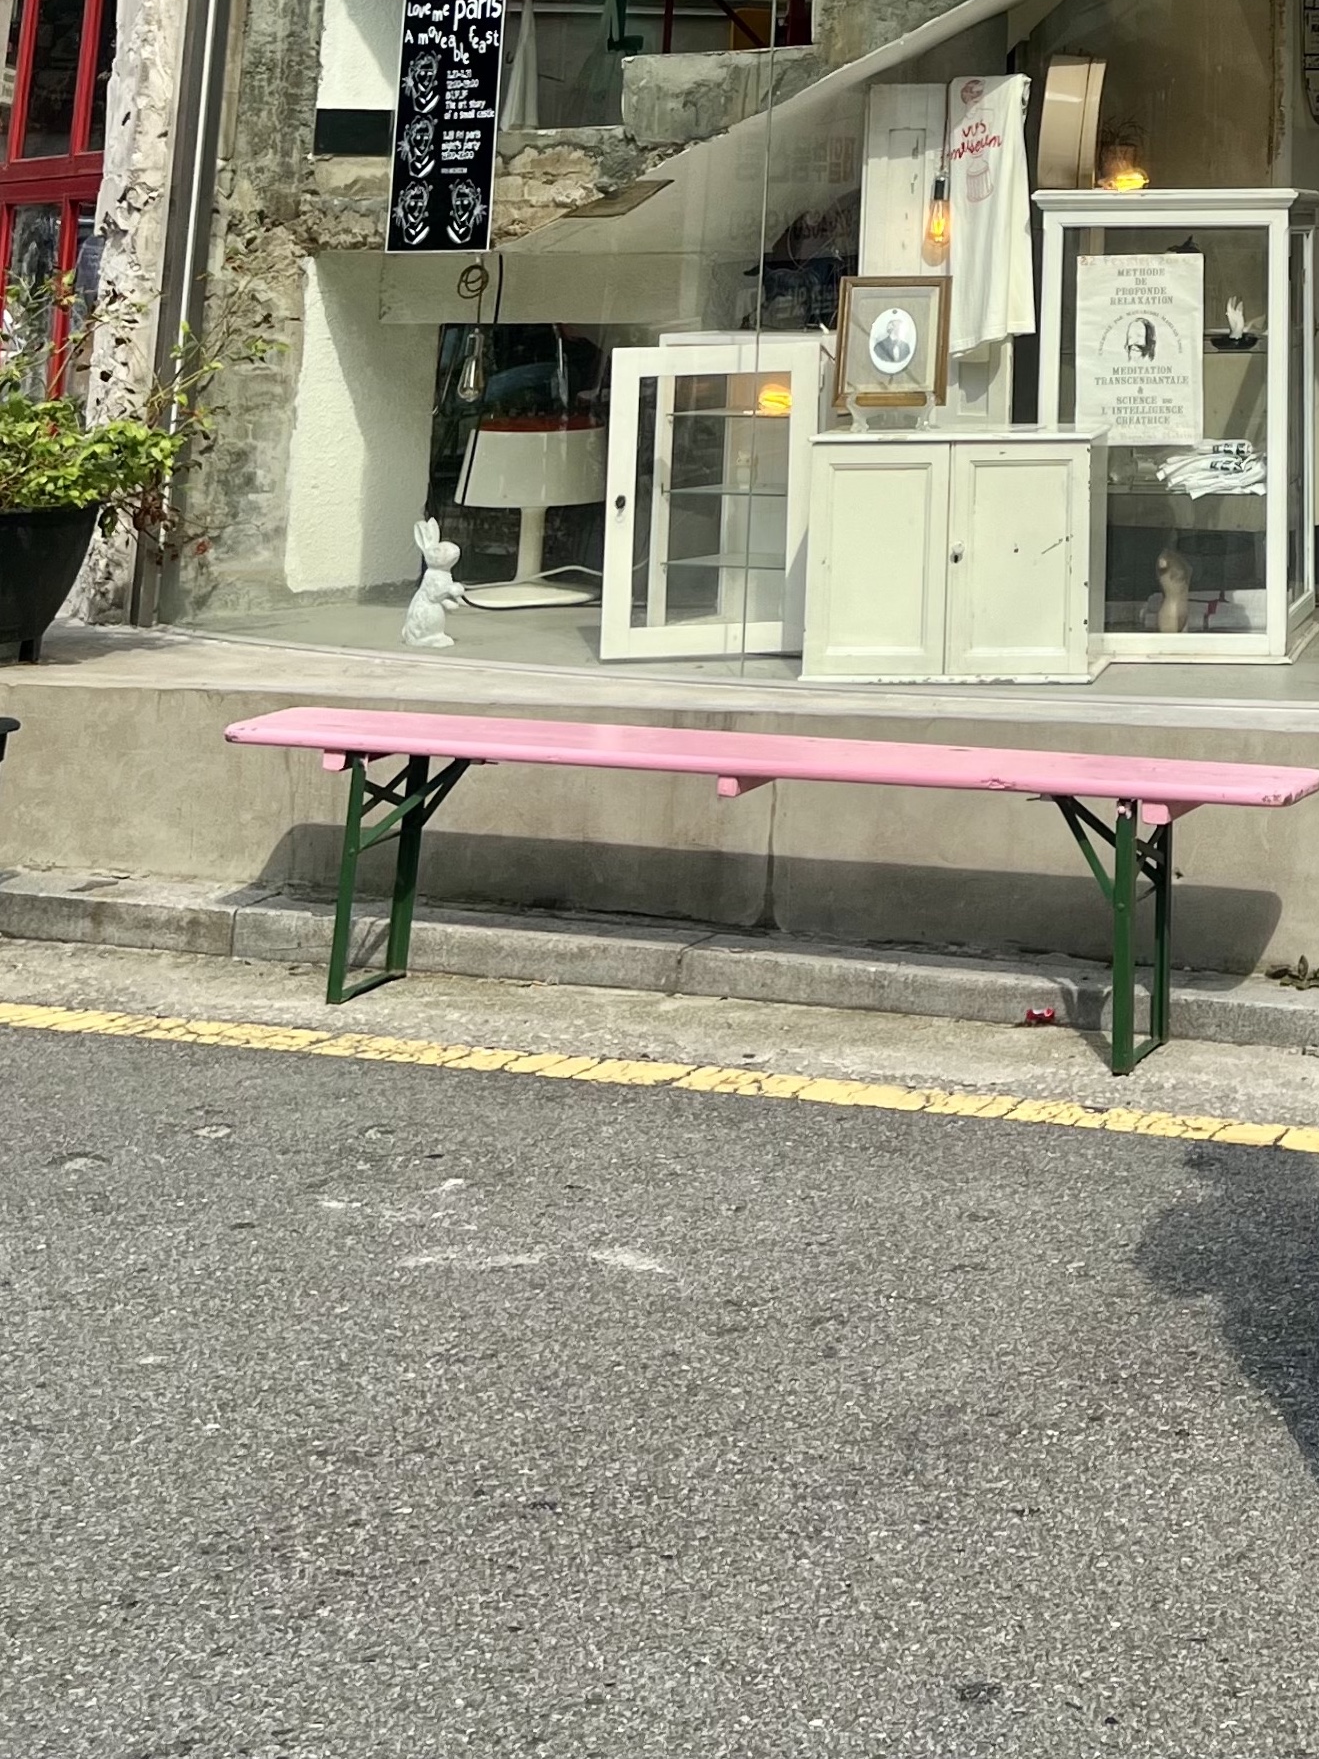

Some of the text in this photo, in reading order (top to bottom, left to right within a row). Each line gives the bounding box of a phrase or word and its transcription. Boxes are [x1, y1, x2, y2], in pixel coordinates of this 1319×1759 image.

[407, 2, 432, 19] Love
[431, 3, 450, 22] me
[404, 29, 414, 44] A
[468, 25, 500, 54] feast
[1117, 268, 1165, 277] METHODE
[1135, 277, 1147, 286] DE
[1115, 287, 1167, 296] PROFONDE
[1109, 296, 1173, 305] RELAXATION
[1112, 366, 1172, 375] MEDITATION
[1094, 376, 1189, 386] TRANSCENDANTALE
[1116, 396, 1157, 404] SCIENCE
[1115, 416, 1170, 425] CREATRICE
